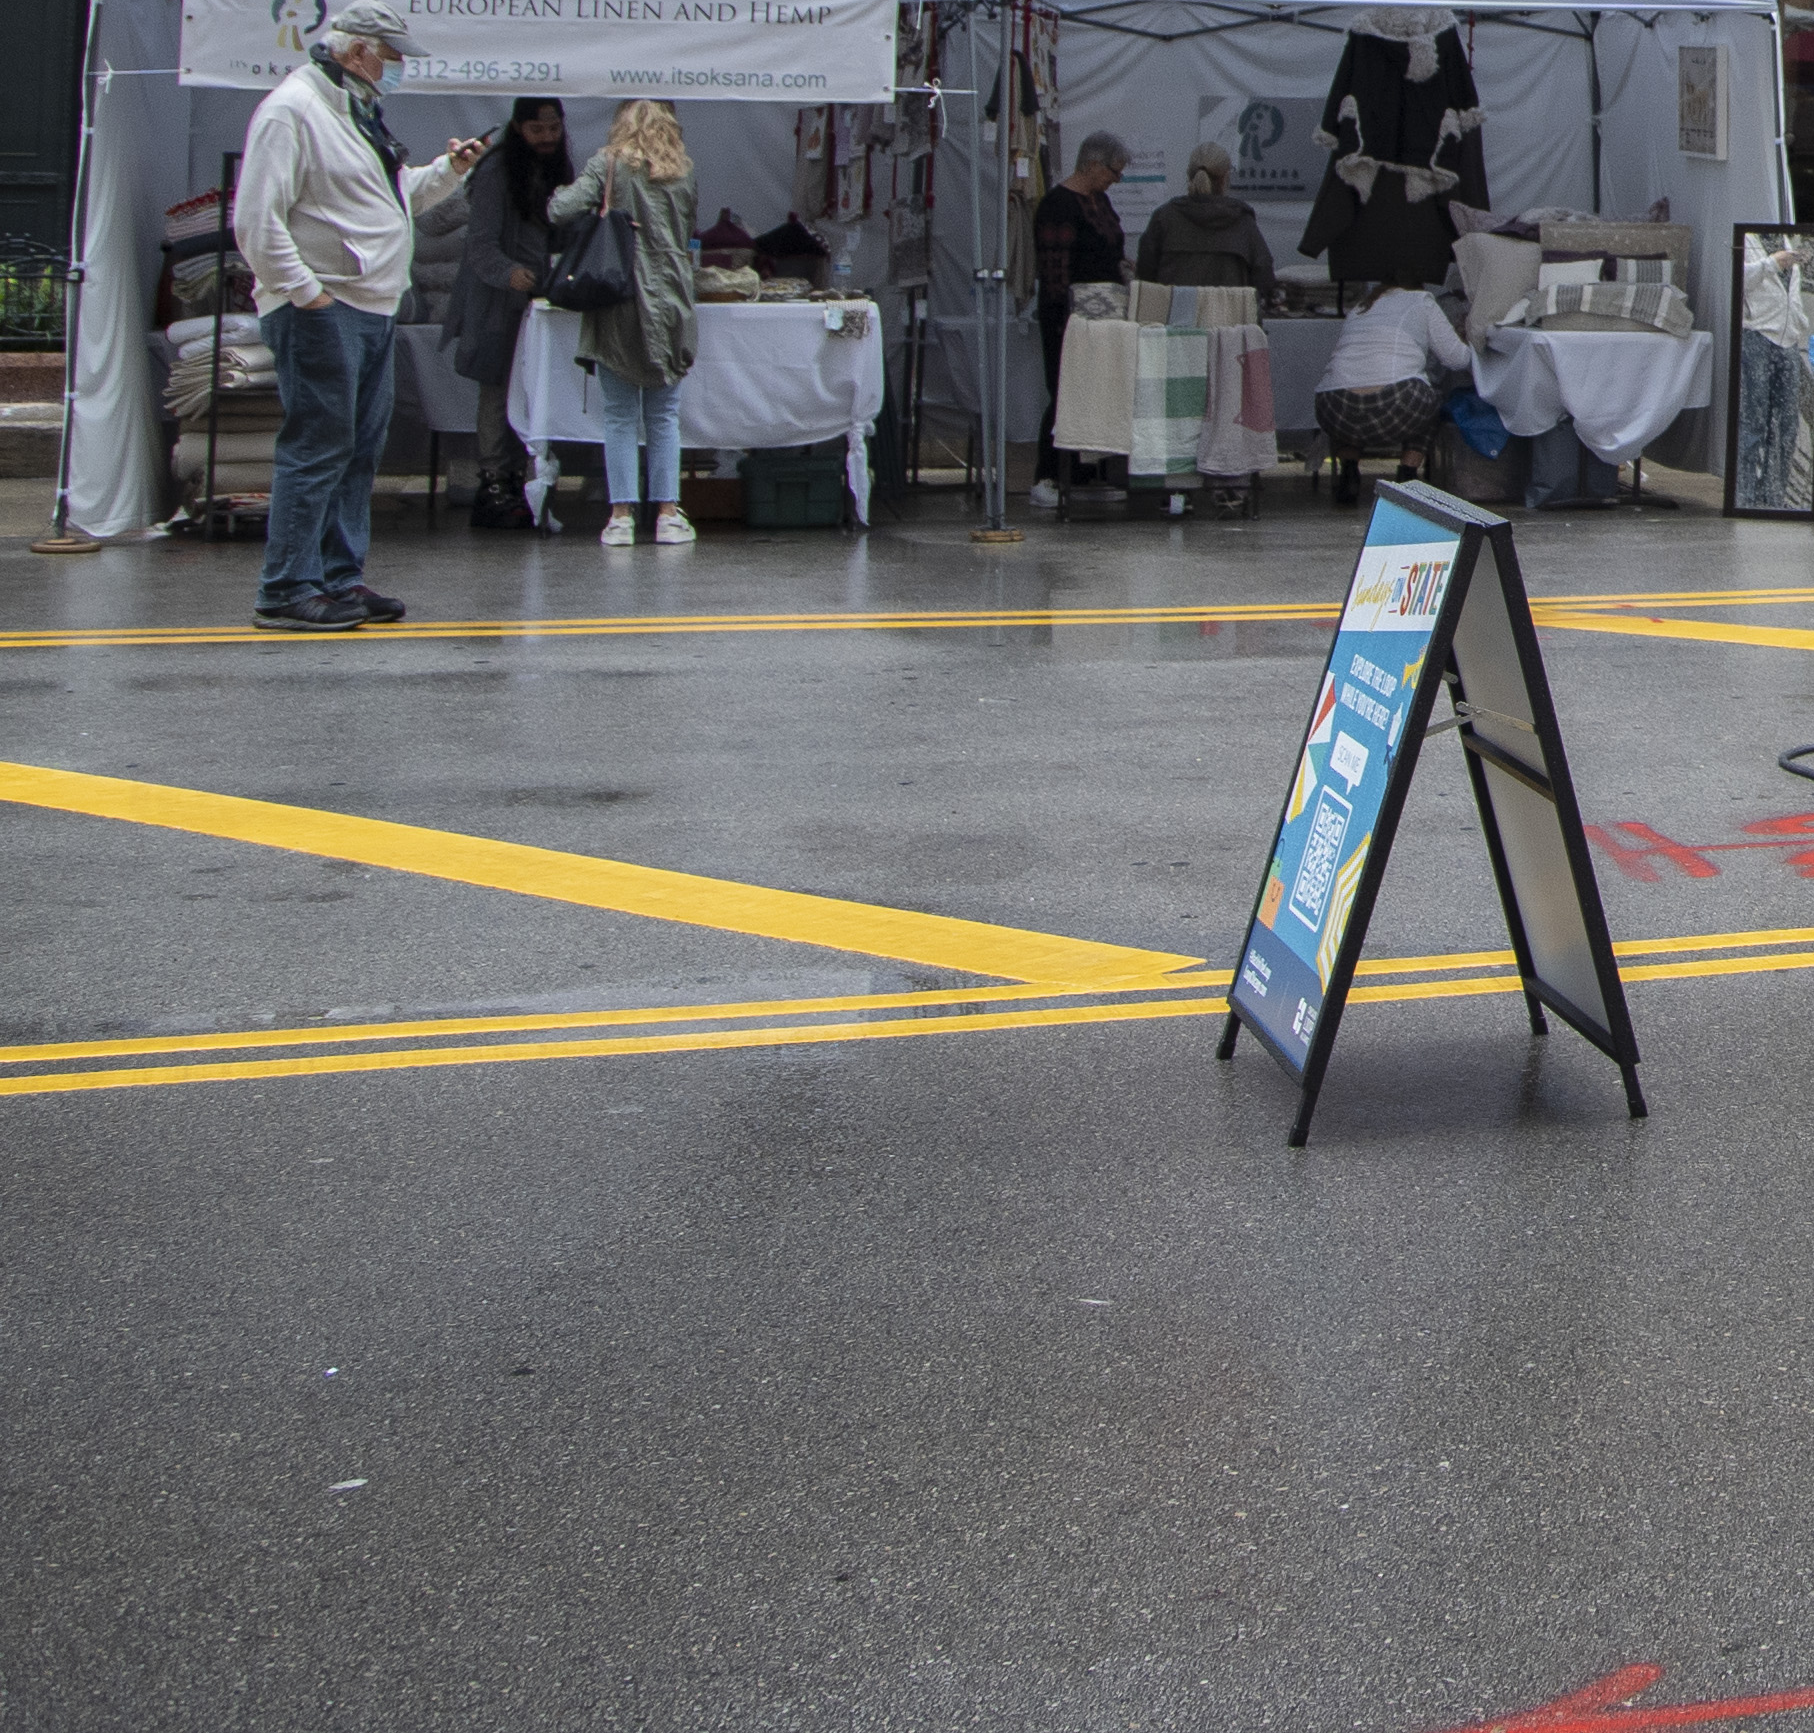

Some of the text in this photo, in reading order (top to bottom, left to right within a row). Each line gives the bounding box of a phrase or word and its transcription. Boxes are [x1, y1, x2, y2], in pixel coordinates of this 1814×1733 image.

[673, 1, 737, 22] AND
[749, 0, 832, 26] HEMP
[408, 59, 562, 82] 312-496-3291
[609, 66, 827, 89] www.itsoksana.com
[1400, 560, 1451, 616] STATE
[1379, 672, 1398, 700] LOOP
